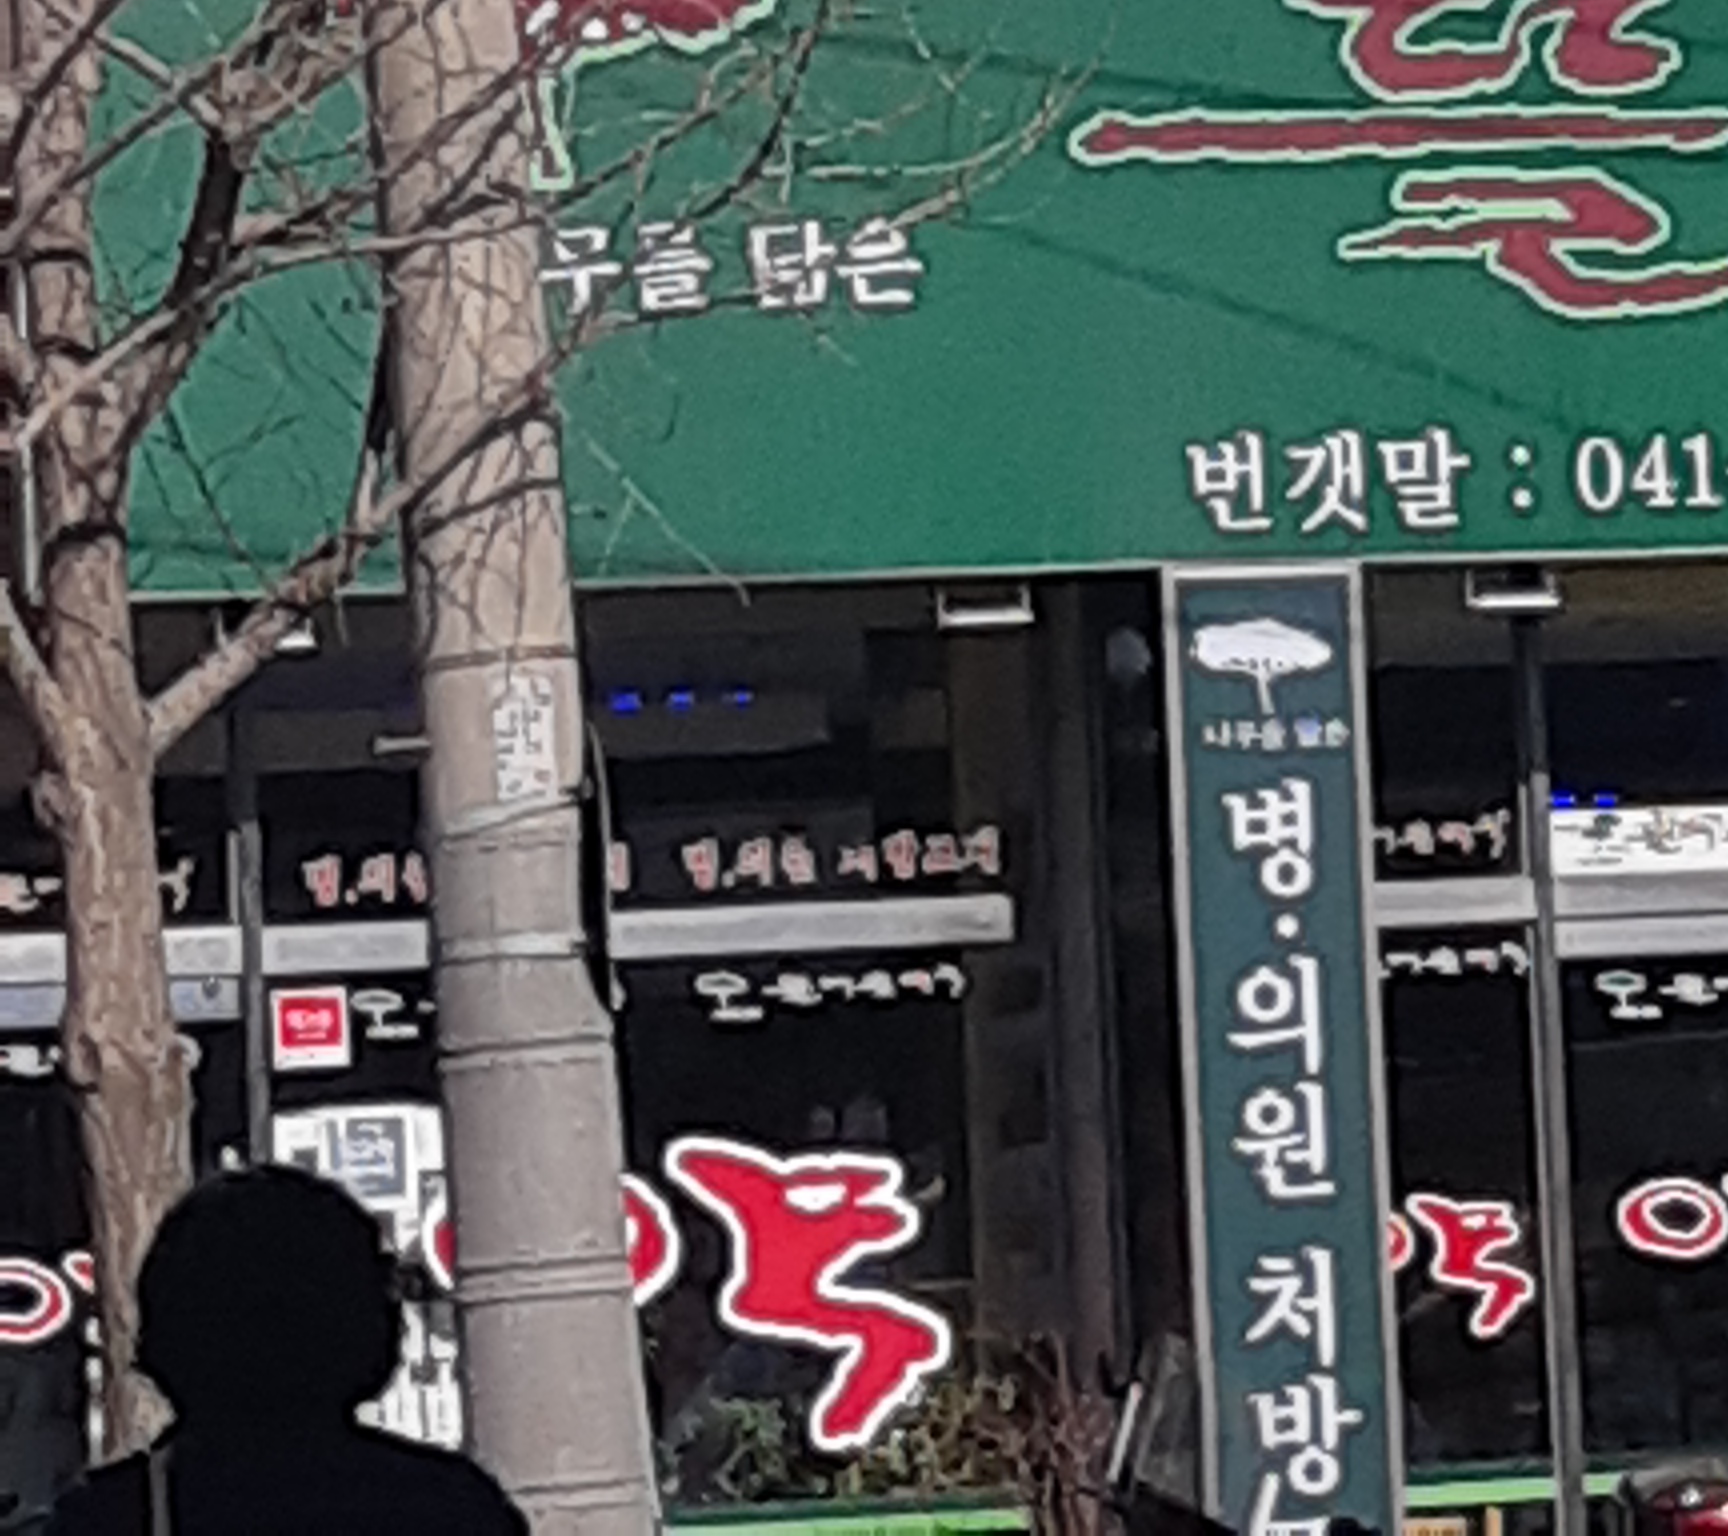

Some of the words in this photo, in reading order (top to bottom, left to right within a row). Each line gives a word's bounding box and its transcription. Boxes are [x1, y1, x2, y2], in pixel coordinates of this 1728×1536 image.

[538, 224, 714, 316] 무를
[1184, 427, 1472, 532] 번갯말
[1244, 1245, 1364, 1496] 처방
